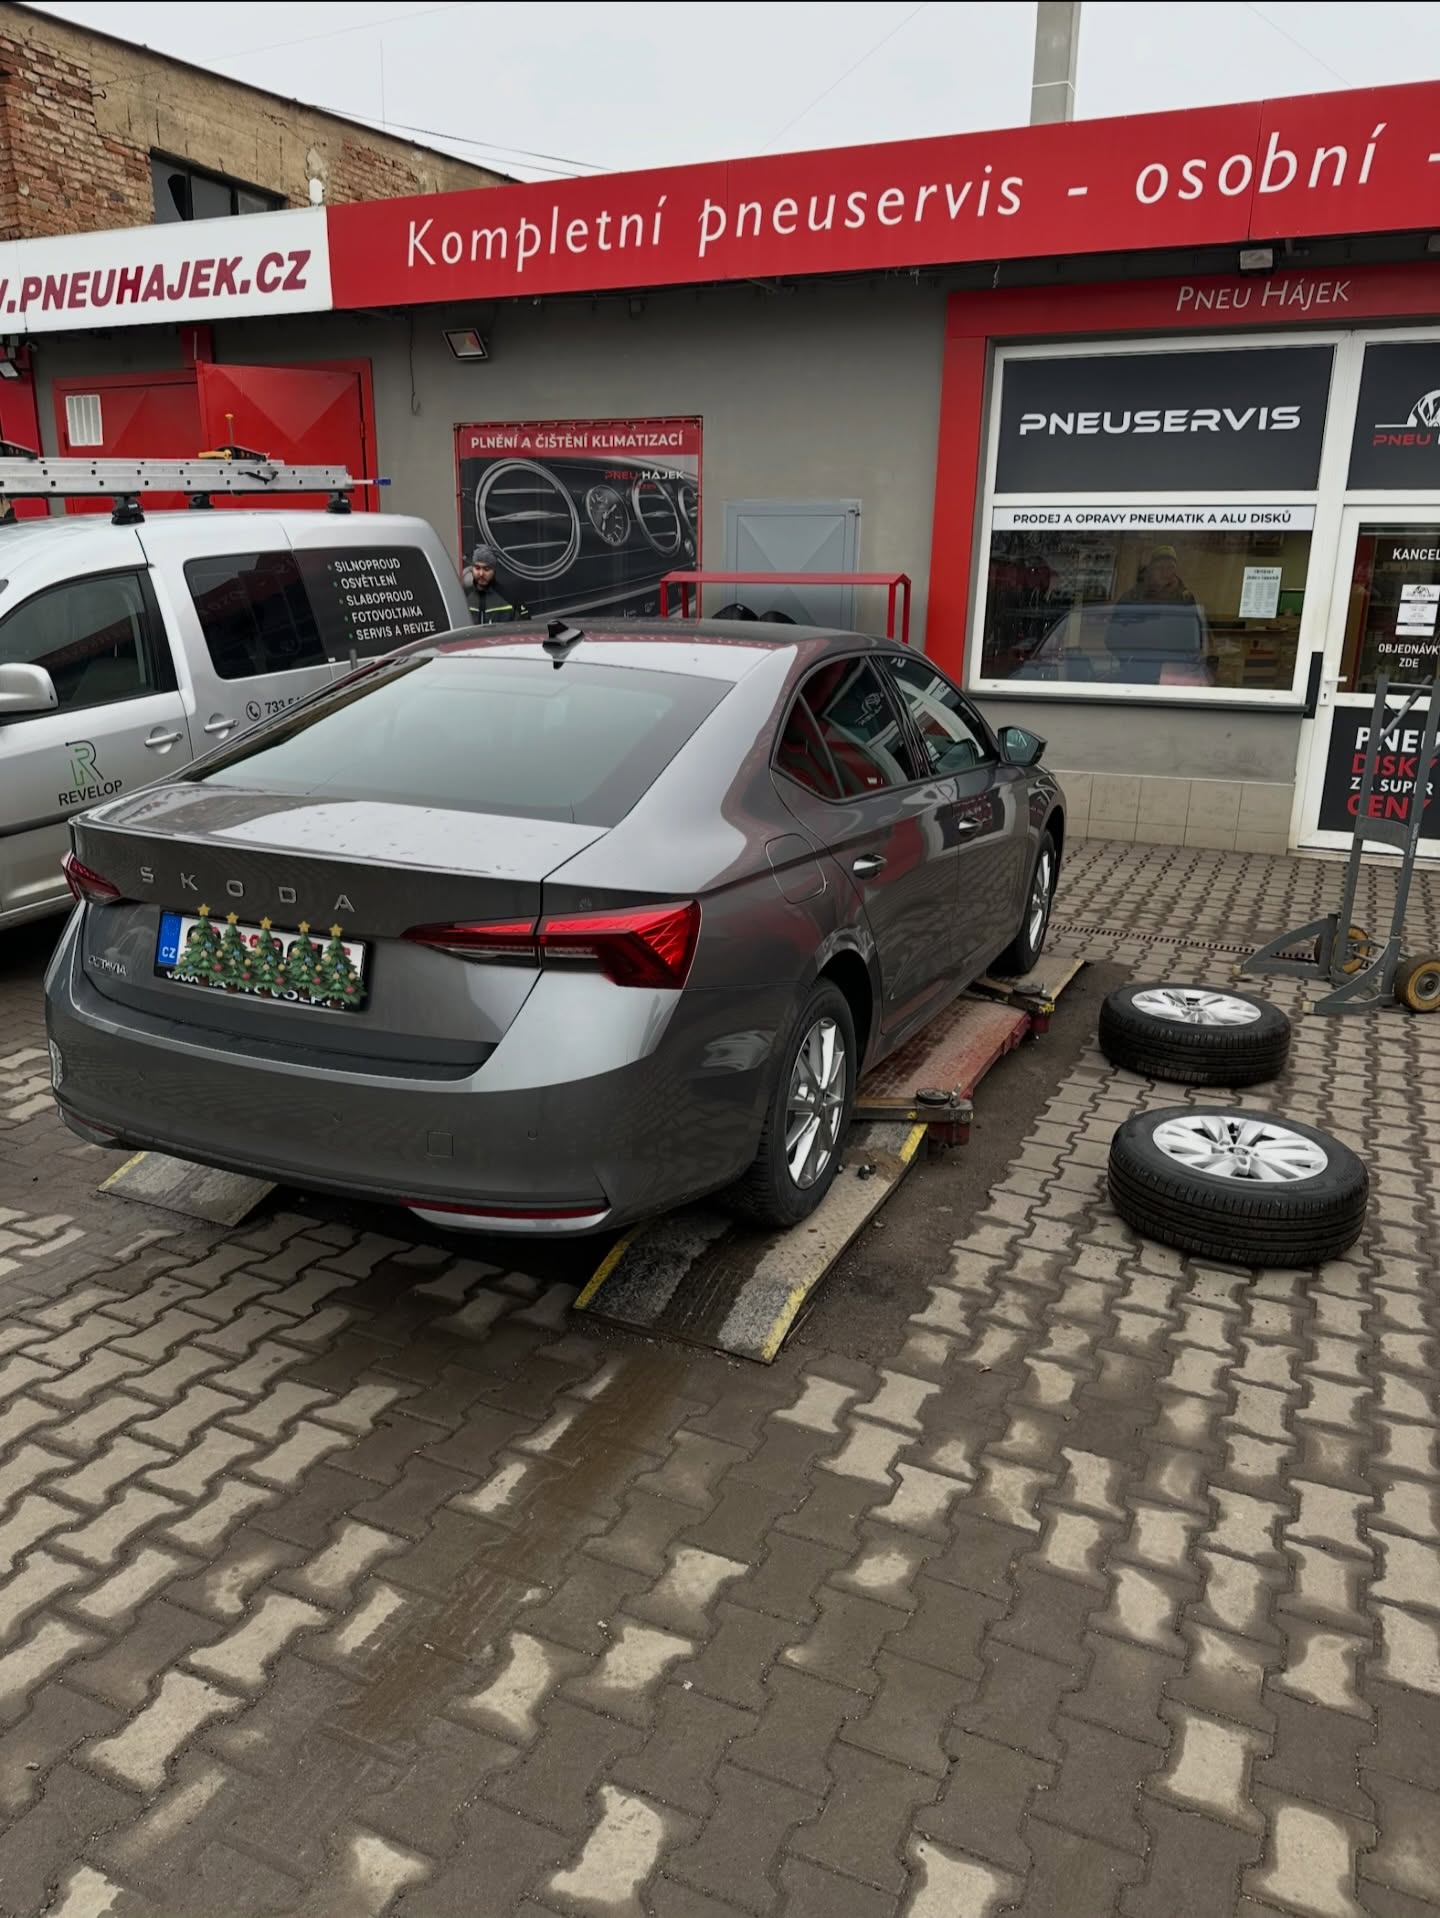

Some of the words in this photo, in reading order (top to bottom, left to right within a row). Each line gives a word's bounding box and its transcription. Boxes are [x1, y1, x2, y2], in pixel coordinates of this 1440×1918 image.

[407, 195, 667, 272] Kompletní
[698, 165, 1023, 258] pneuservis
[1135, 122, 1387, 204] osobní
[0, 249, 311, 313] .PNEUHAJEK.CZ
[1019, 405, 1301, 436] PNEUSERVIS
[471, 434, 518, 449] PLNĚNÍ
[521, 436, 531, 448] A
[535, 432, 588, 448] ČIŠTĚNÍ
[592, 430, 684, 447] KLIMATIZACÍ
[1373, 434, 1432, 446] PNEU
[1013, 513, 1061, 524] PRODEJ
[1063, 513, 1073, 524] A
[1075, 513, 1126, 524] OPRAVY
[1129, 513, 1205, 524] PNEUMATIK
[1207, 513, 1217, 523] A
[1220, 513, 1247, 523] ALU
[1250, 509, 1292, 523] DISKŮ
[334, 558, 401, 573] SILNOPROUD
[340, 572, 397, 589] OSVĚTLENÍ
[346, 590, 413, 606] SLABOPROUD
[351, 605, 423, 623] FOTOVOLTAIKA
[356, 625, 393, 640] SERVIS
[395, 624, 402, 635] A
[403, 621, 436, 634] REVIZE
[1378, 642, 1440, 655] OBJEDNÁVK
[1399, 658, 1419, 668] ZDE
[58, 780, 123, 806] REVELOP
[1380, 780, 1434, 796] SUPR
[161, 945, 177, 959] CZ
